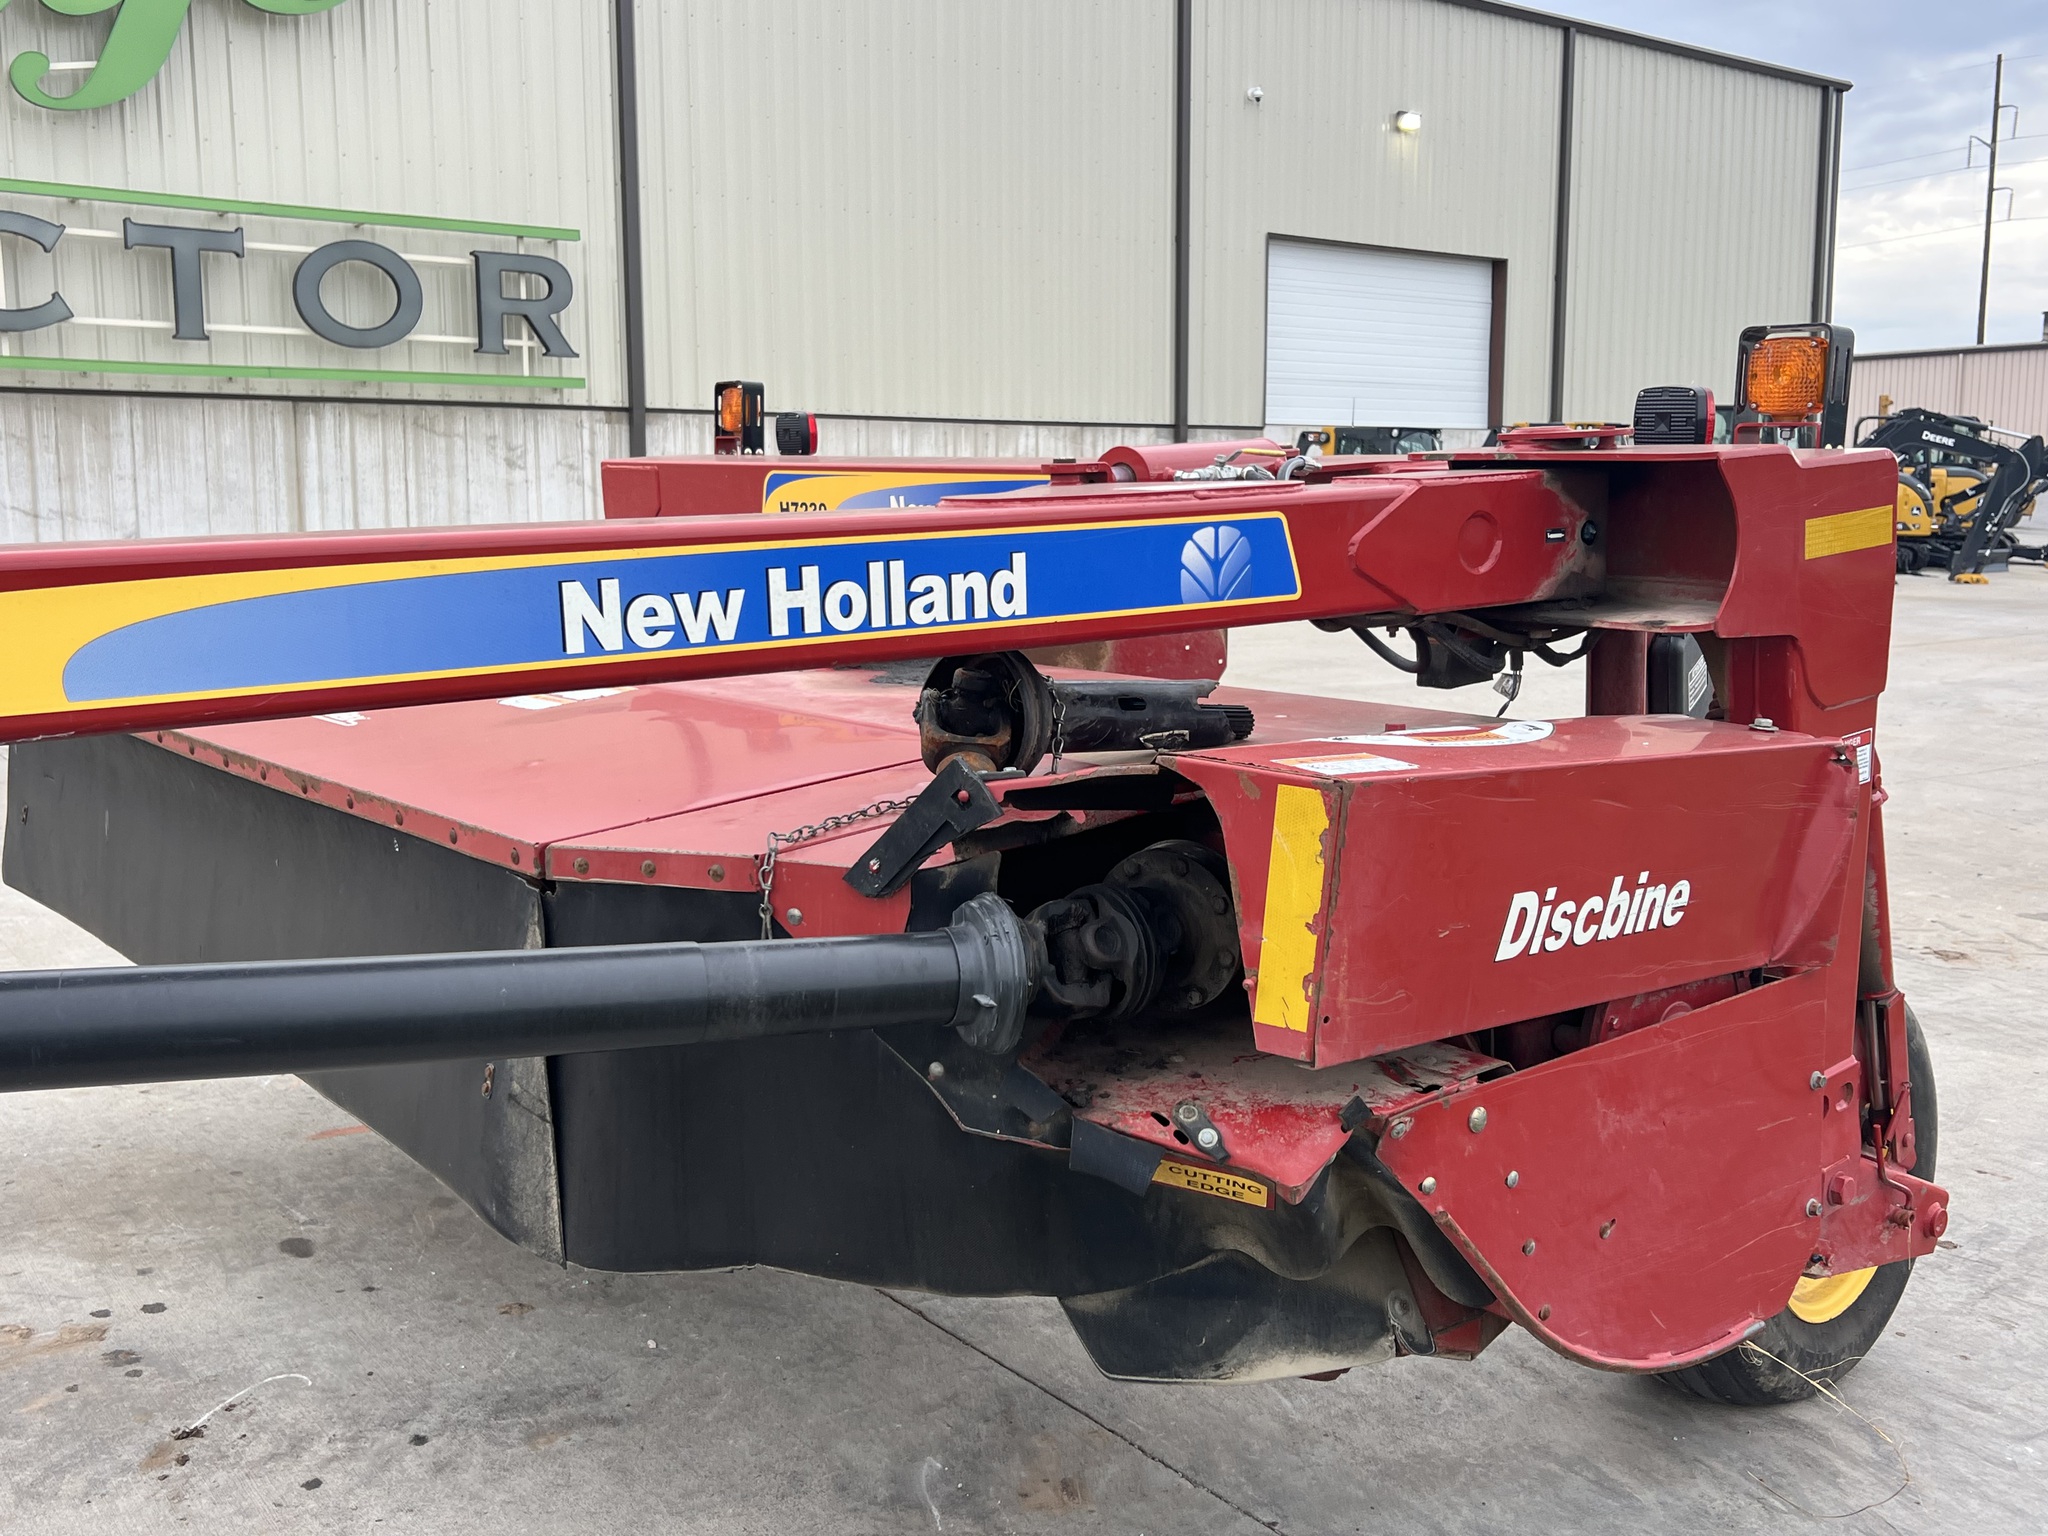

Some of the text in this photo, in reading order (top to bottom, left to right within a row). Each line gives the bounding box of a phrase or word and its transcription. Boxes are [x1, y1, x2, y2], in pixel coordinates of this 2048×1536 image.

[1922, 430, 1956, 447] DEERE
[558, 551, 1028, 655] New Holland
[1494, 871, 1691, 963] Discbine
[1168, 1166, 1262, 1195] CUTTING
[1186, 1179, 1245, 1200] EDGE
